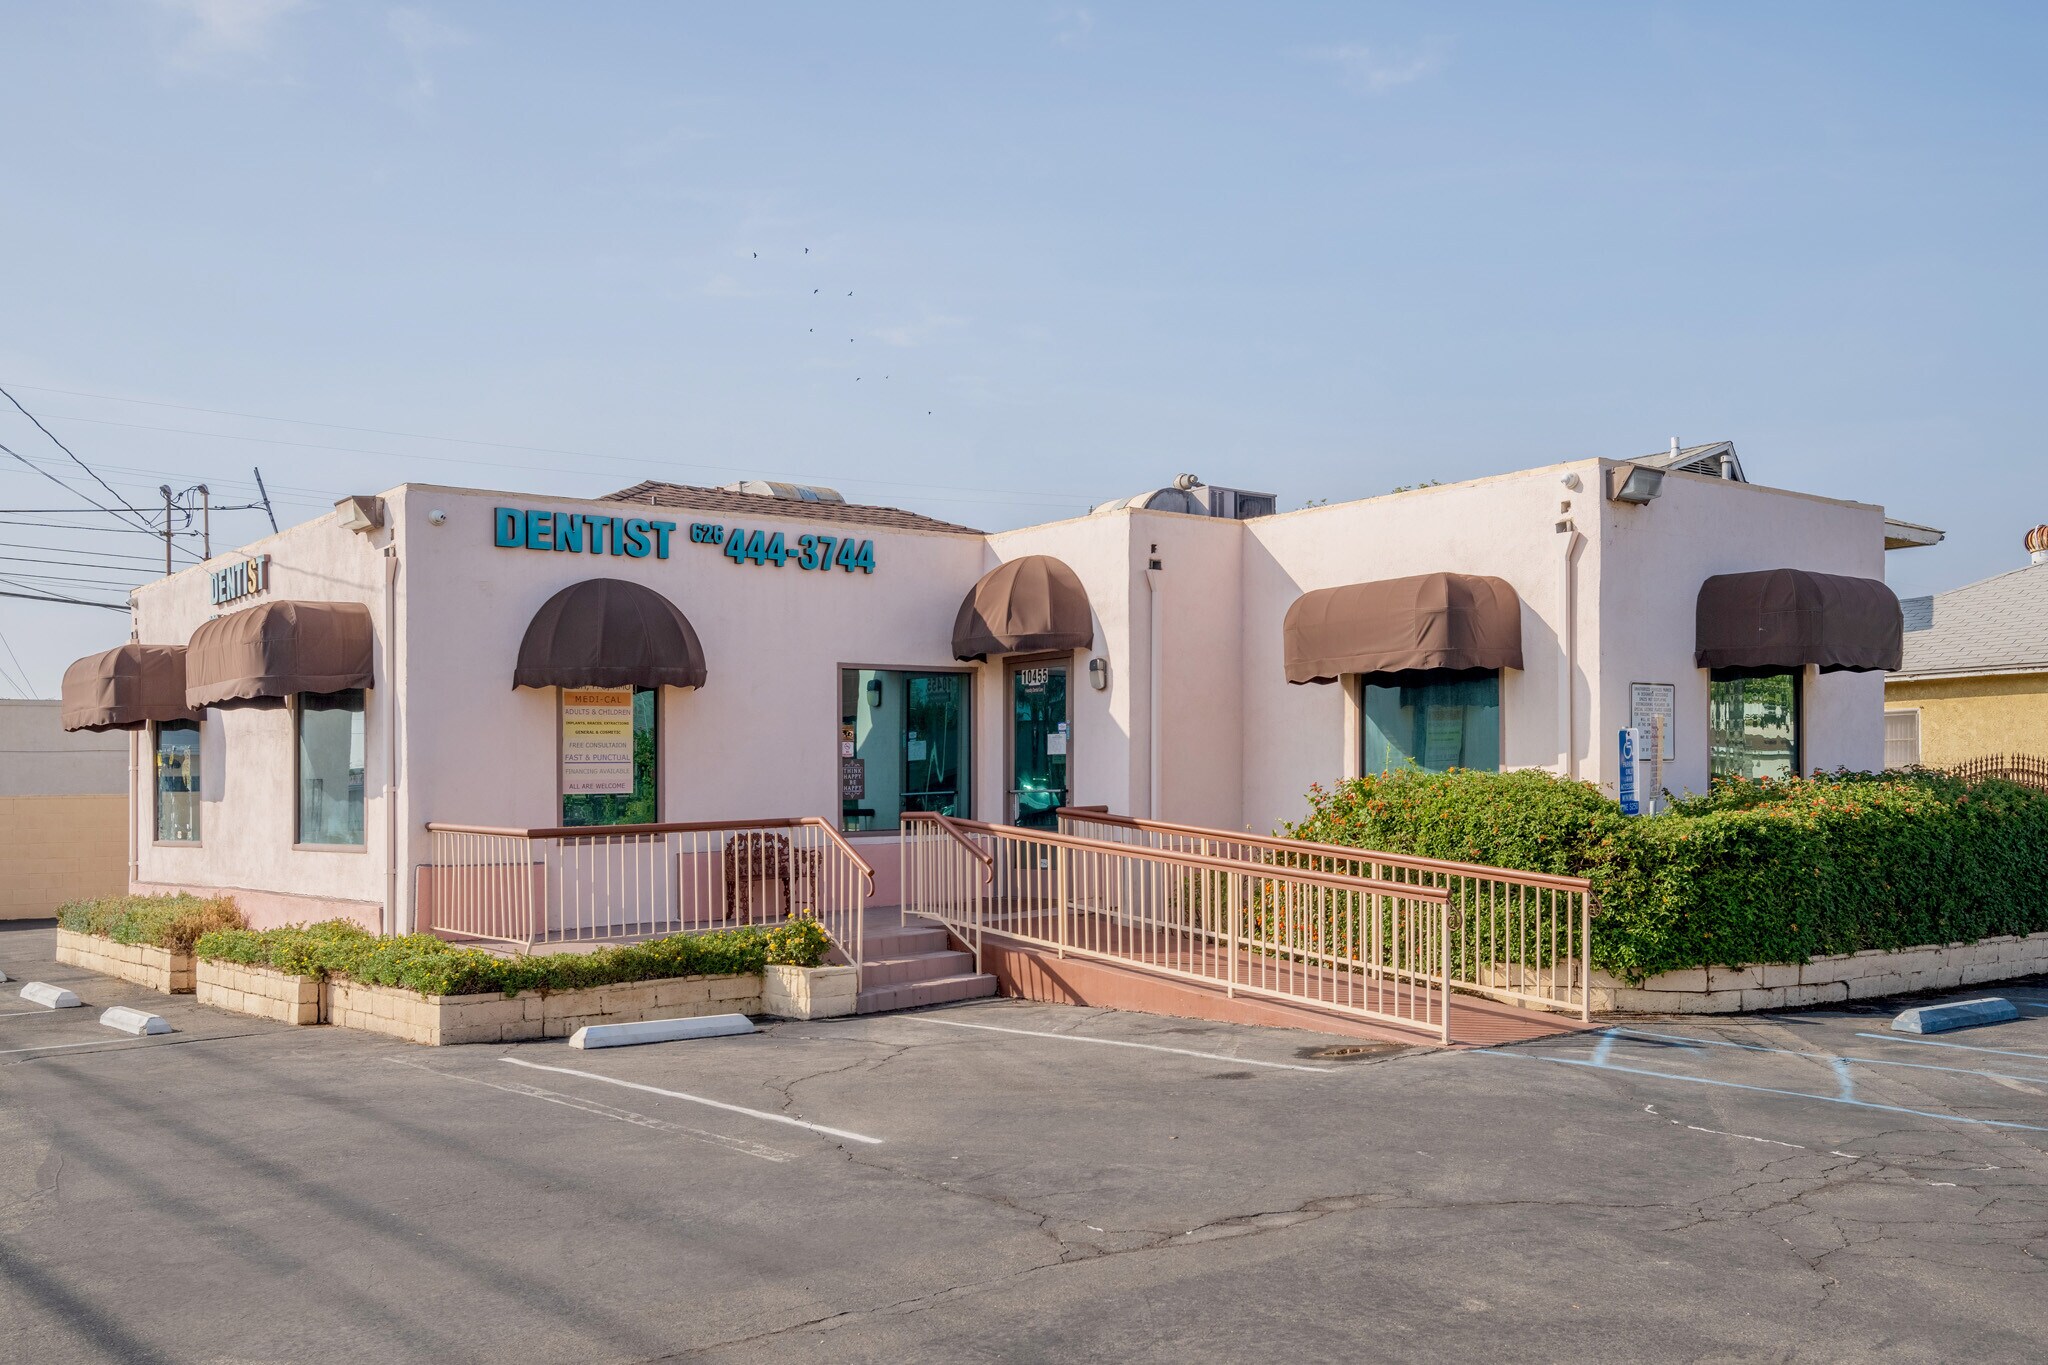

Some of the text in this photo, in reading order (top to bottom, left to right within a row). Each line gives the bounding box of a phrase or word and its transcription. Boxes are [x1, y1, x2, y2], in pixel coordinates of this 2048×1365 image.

[494, 507, 677, 559] DENTIST
[690, 522, 876, 574] 626 444-3744
[209, 554, 271, 605] DENTIST
[575, 695, 622, 704] MEDI-CAL
[1023, 668, 1047, 684] 10455
